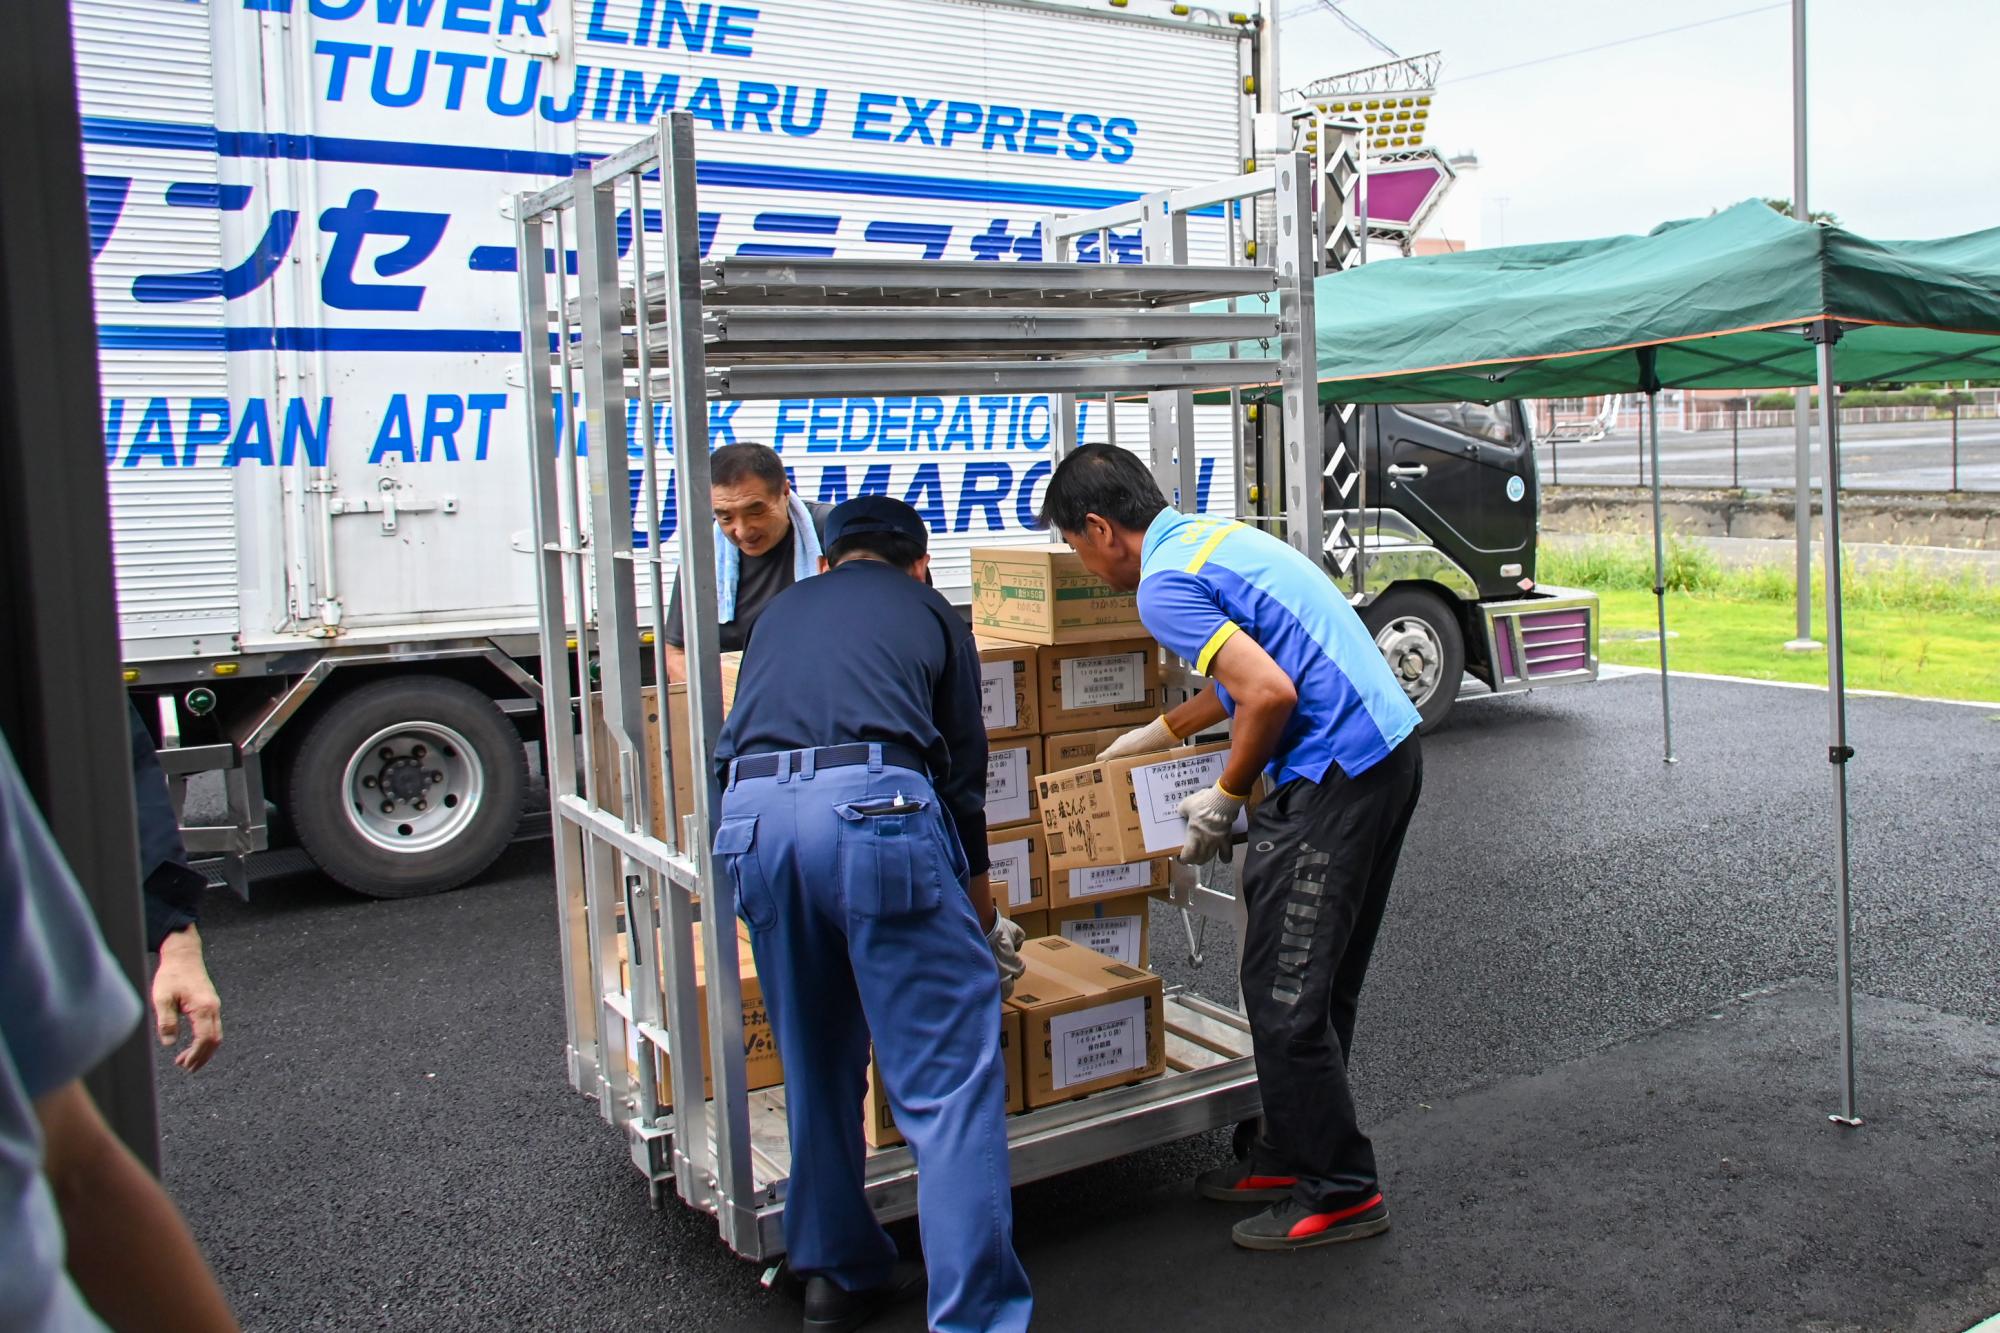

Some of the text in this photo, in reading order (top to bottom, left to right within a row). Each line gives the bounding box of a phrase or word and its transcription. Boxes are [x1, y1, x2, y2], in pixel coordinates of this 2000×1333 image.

[587, 0, 759, 57] LINE
[315, 40, 1138, 164] TUTUJIMARU EXPRESS
[107, 396, 333, 467] JAPAN
[368, 393, 507, 463] ART
[774, 396, 1086, 453] FEDERATIO
